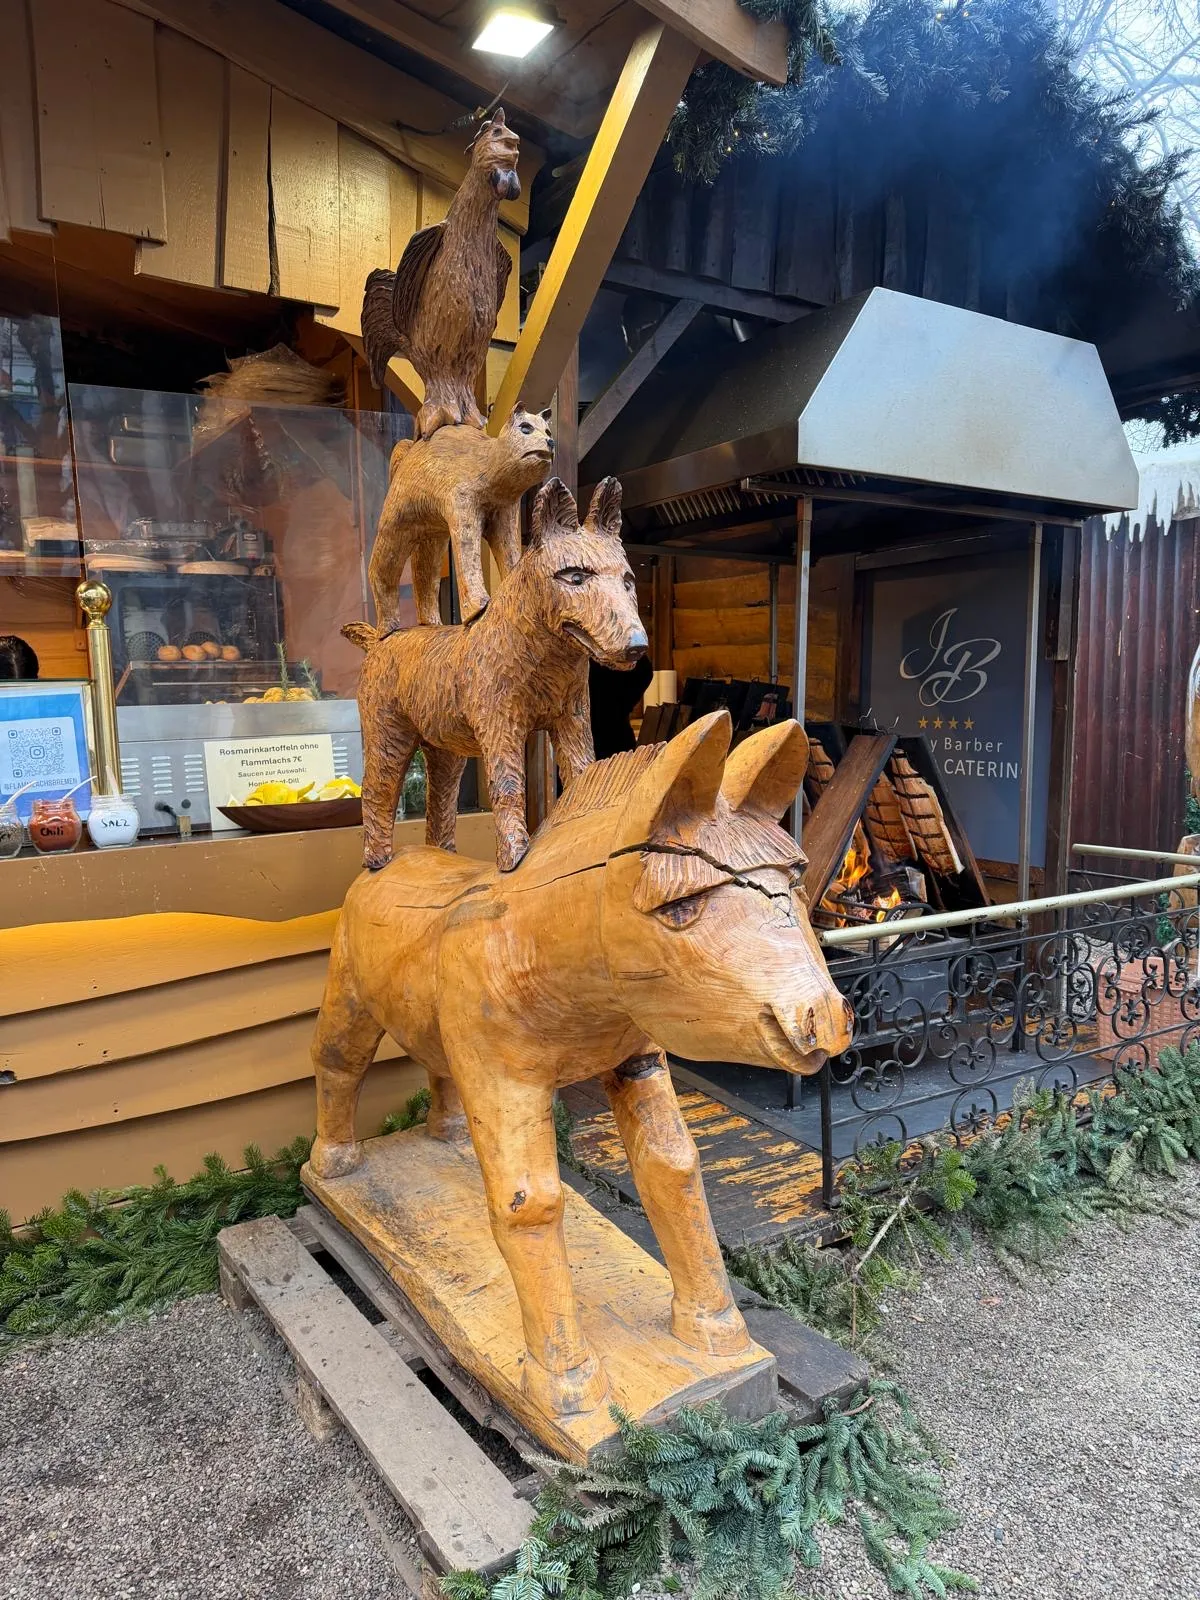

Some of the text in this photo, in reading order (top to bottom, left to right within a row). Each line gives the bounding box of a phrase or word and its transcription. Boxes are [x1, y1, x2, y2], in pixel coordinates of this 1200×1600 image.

[220, 744, 298, 756] Rosmarinkartoffeln
[944, 737, 1004, 753] Barber
[241, 757, 292, 767] Flammlachs
[277, 767, 307, 775] Auswahl:
[944, 758, 1022, 779] CATERIN
[40, 825, 64, 837] Chili
